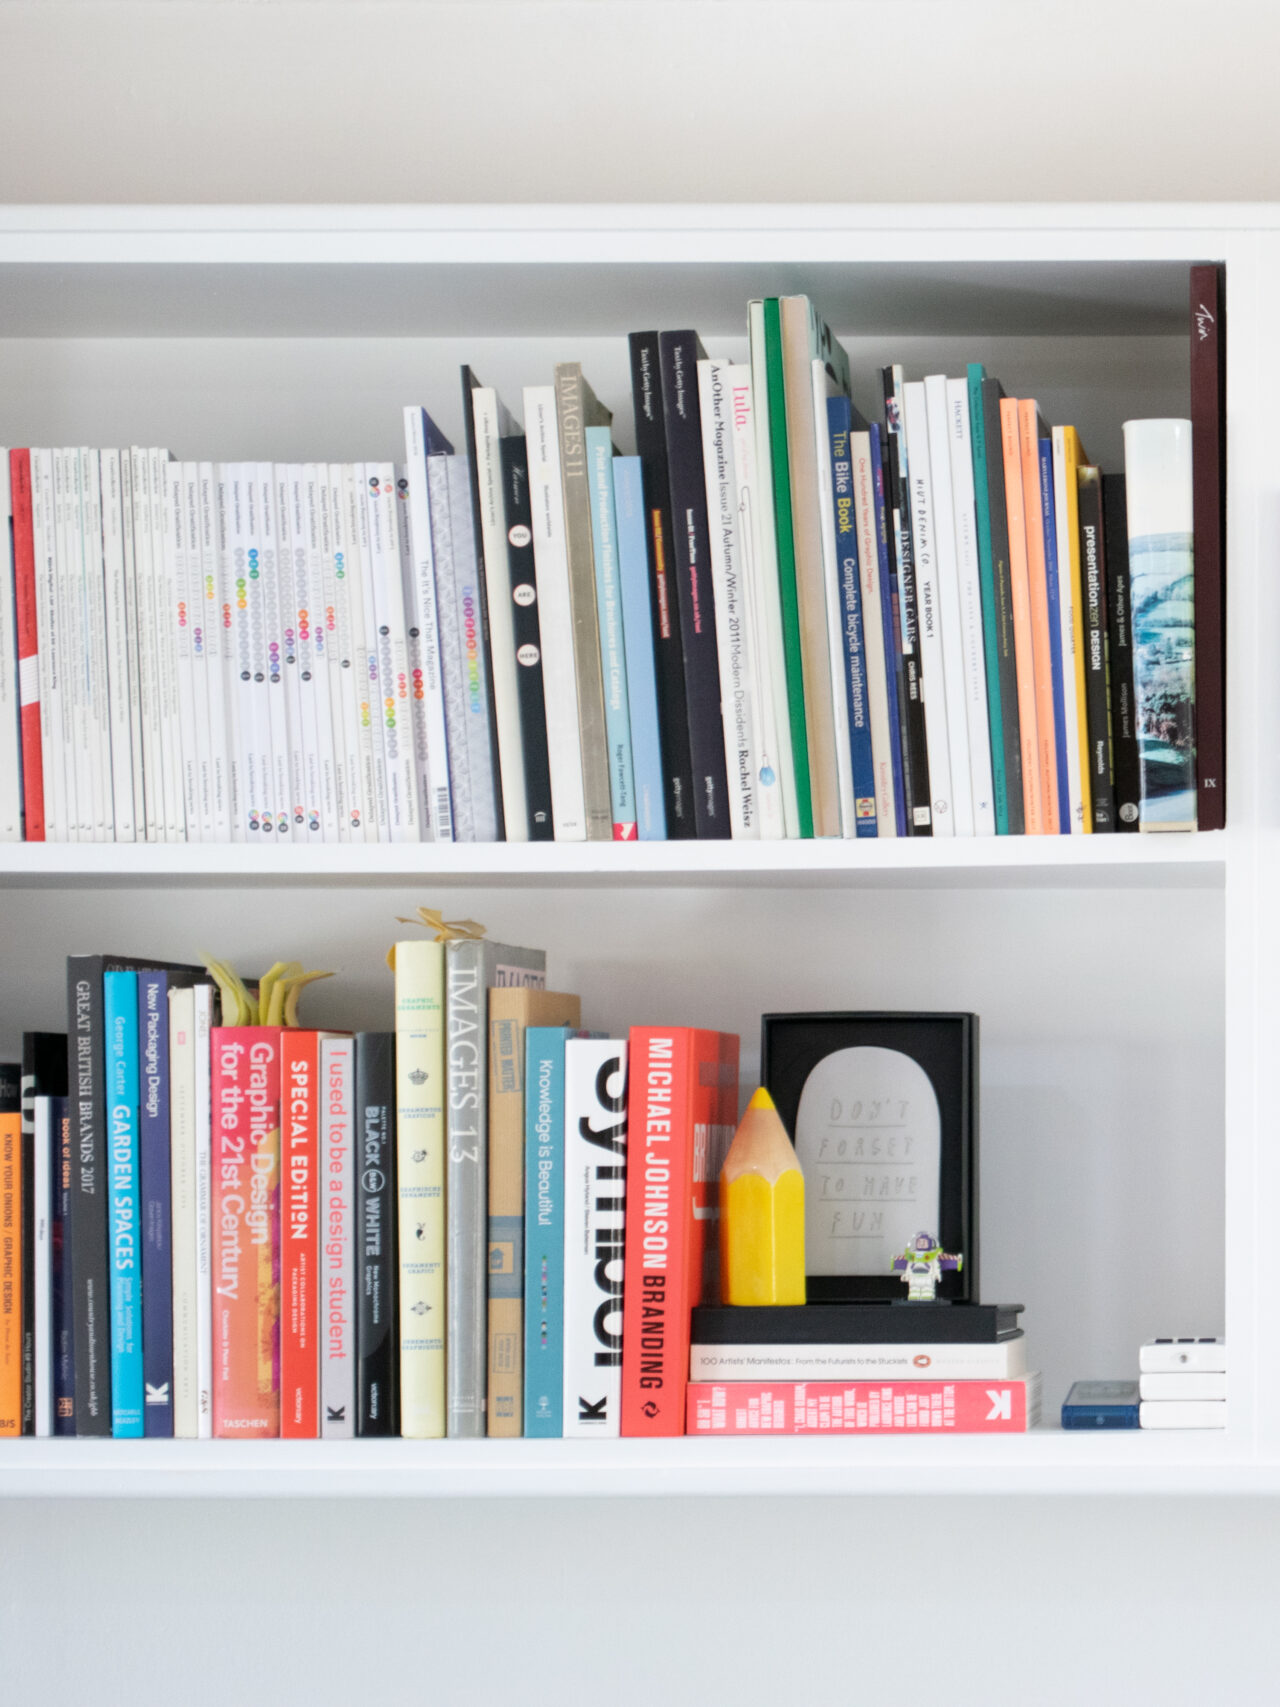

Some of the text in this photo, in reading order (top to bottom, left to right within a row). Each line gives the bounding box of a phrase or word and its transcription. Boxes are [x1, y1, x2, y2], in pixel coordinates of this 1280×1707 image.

[711, 365, 724, 419] AnOther
[560, 375, 584, 477] IMAGES 11
[712, 421, 729, 480] Magazine
[719, 482, 730, 512] Issue
[420, 561, 429, 578] The
[596, 447, 621, 710] Print and Production Finishes for Brochures and Catalogs
[722, 528, 738, 614] Autumn/Winter
[833, 431, 864, 728] The Bike Book Complete bicycle maintenance
[423, 598, 432, 618] Nice
[1083, 525, 1101, 671] presentationzen DESIGN
[424, 622, 435, 644] That
[728, 617, 741, 643] 2011
[425, 647, 437, 690] Magazine
[731, 644, 742, 688] Modern
[734, 690, 747, 748] Dissidents
[615, 743, 624, 763] Roger
[738, 749, 752, 792] Rachel
[742, 793, 754, 828] Weisz
[76, 980, 95, 1195] GREAT BRITISH BRANDS 2017
[329, 1063, 348, 1116] used
[449, 965, 479, 1167] IMAGES 13
[245, 1042, 274, 1245] Graphic Design
[329, 1122, 347, 1144] to
[329, 1147, 348, 1174] be
[535, 1059, 554, 1226] Knowledge is Beautiful
[111, 1105, 134, 1271] GARDEN SPACES
[216, 1042, 247, 1299] for the 21st Century
[329, 1179, 343, 1192] a
[820, 1176, 844, 1194] TO
[325, 1196, 348, 1270] design
[639, 1038, 673, 1389] MICHAEL JOHNSON BRANDING
[329, 1277, 348, 1360] student
